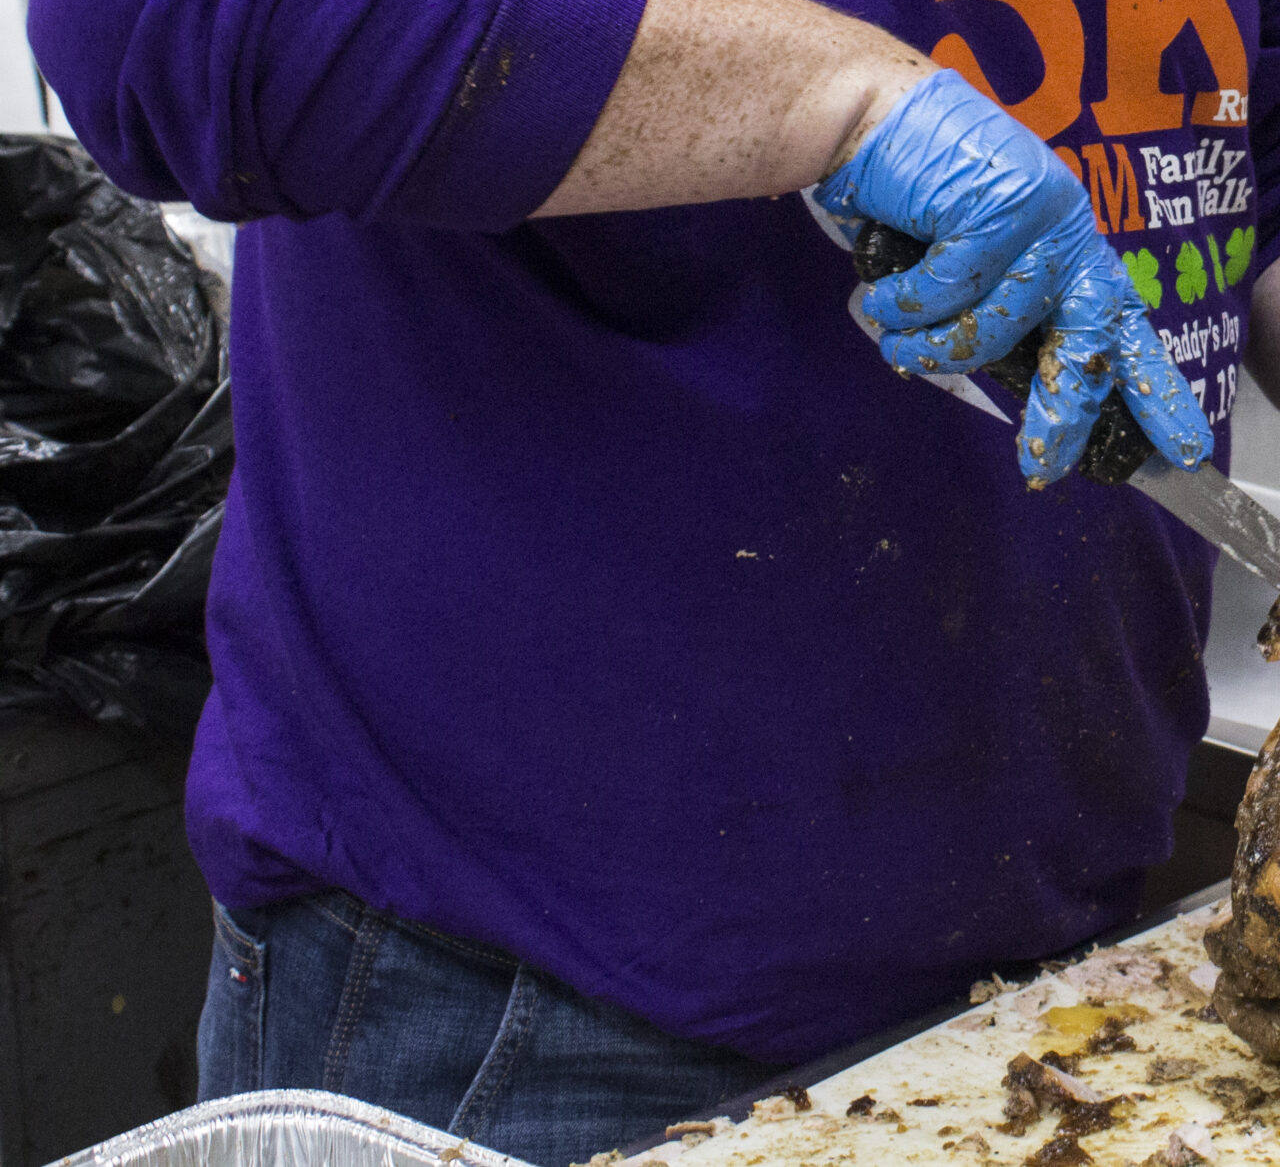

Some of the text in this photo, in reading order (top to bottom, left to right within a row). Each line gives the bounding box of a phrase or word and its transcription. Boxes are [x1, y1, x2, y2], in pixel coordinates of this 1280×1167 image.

[1144, 190, 1195, 229] Fun
[1158, 311, 1239, 368] Paddy's Day
